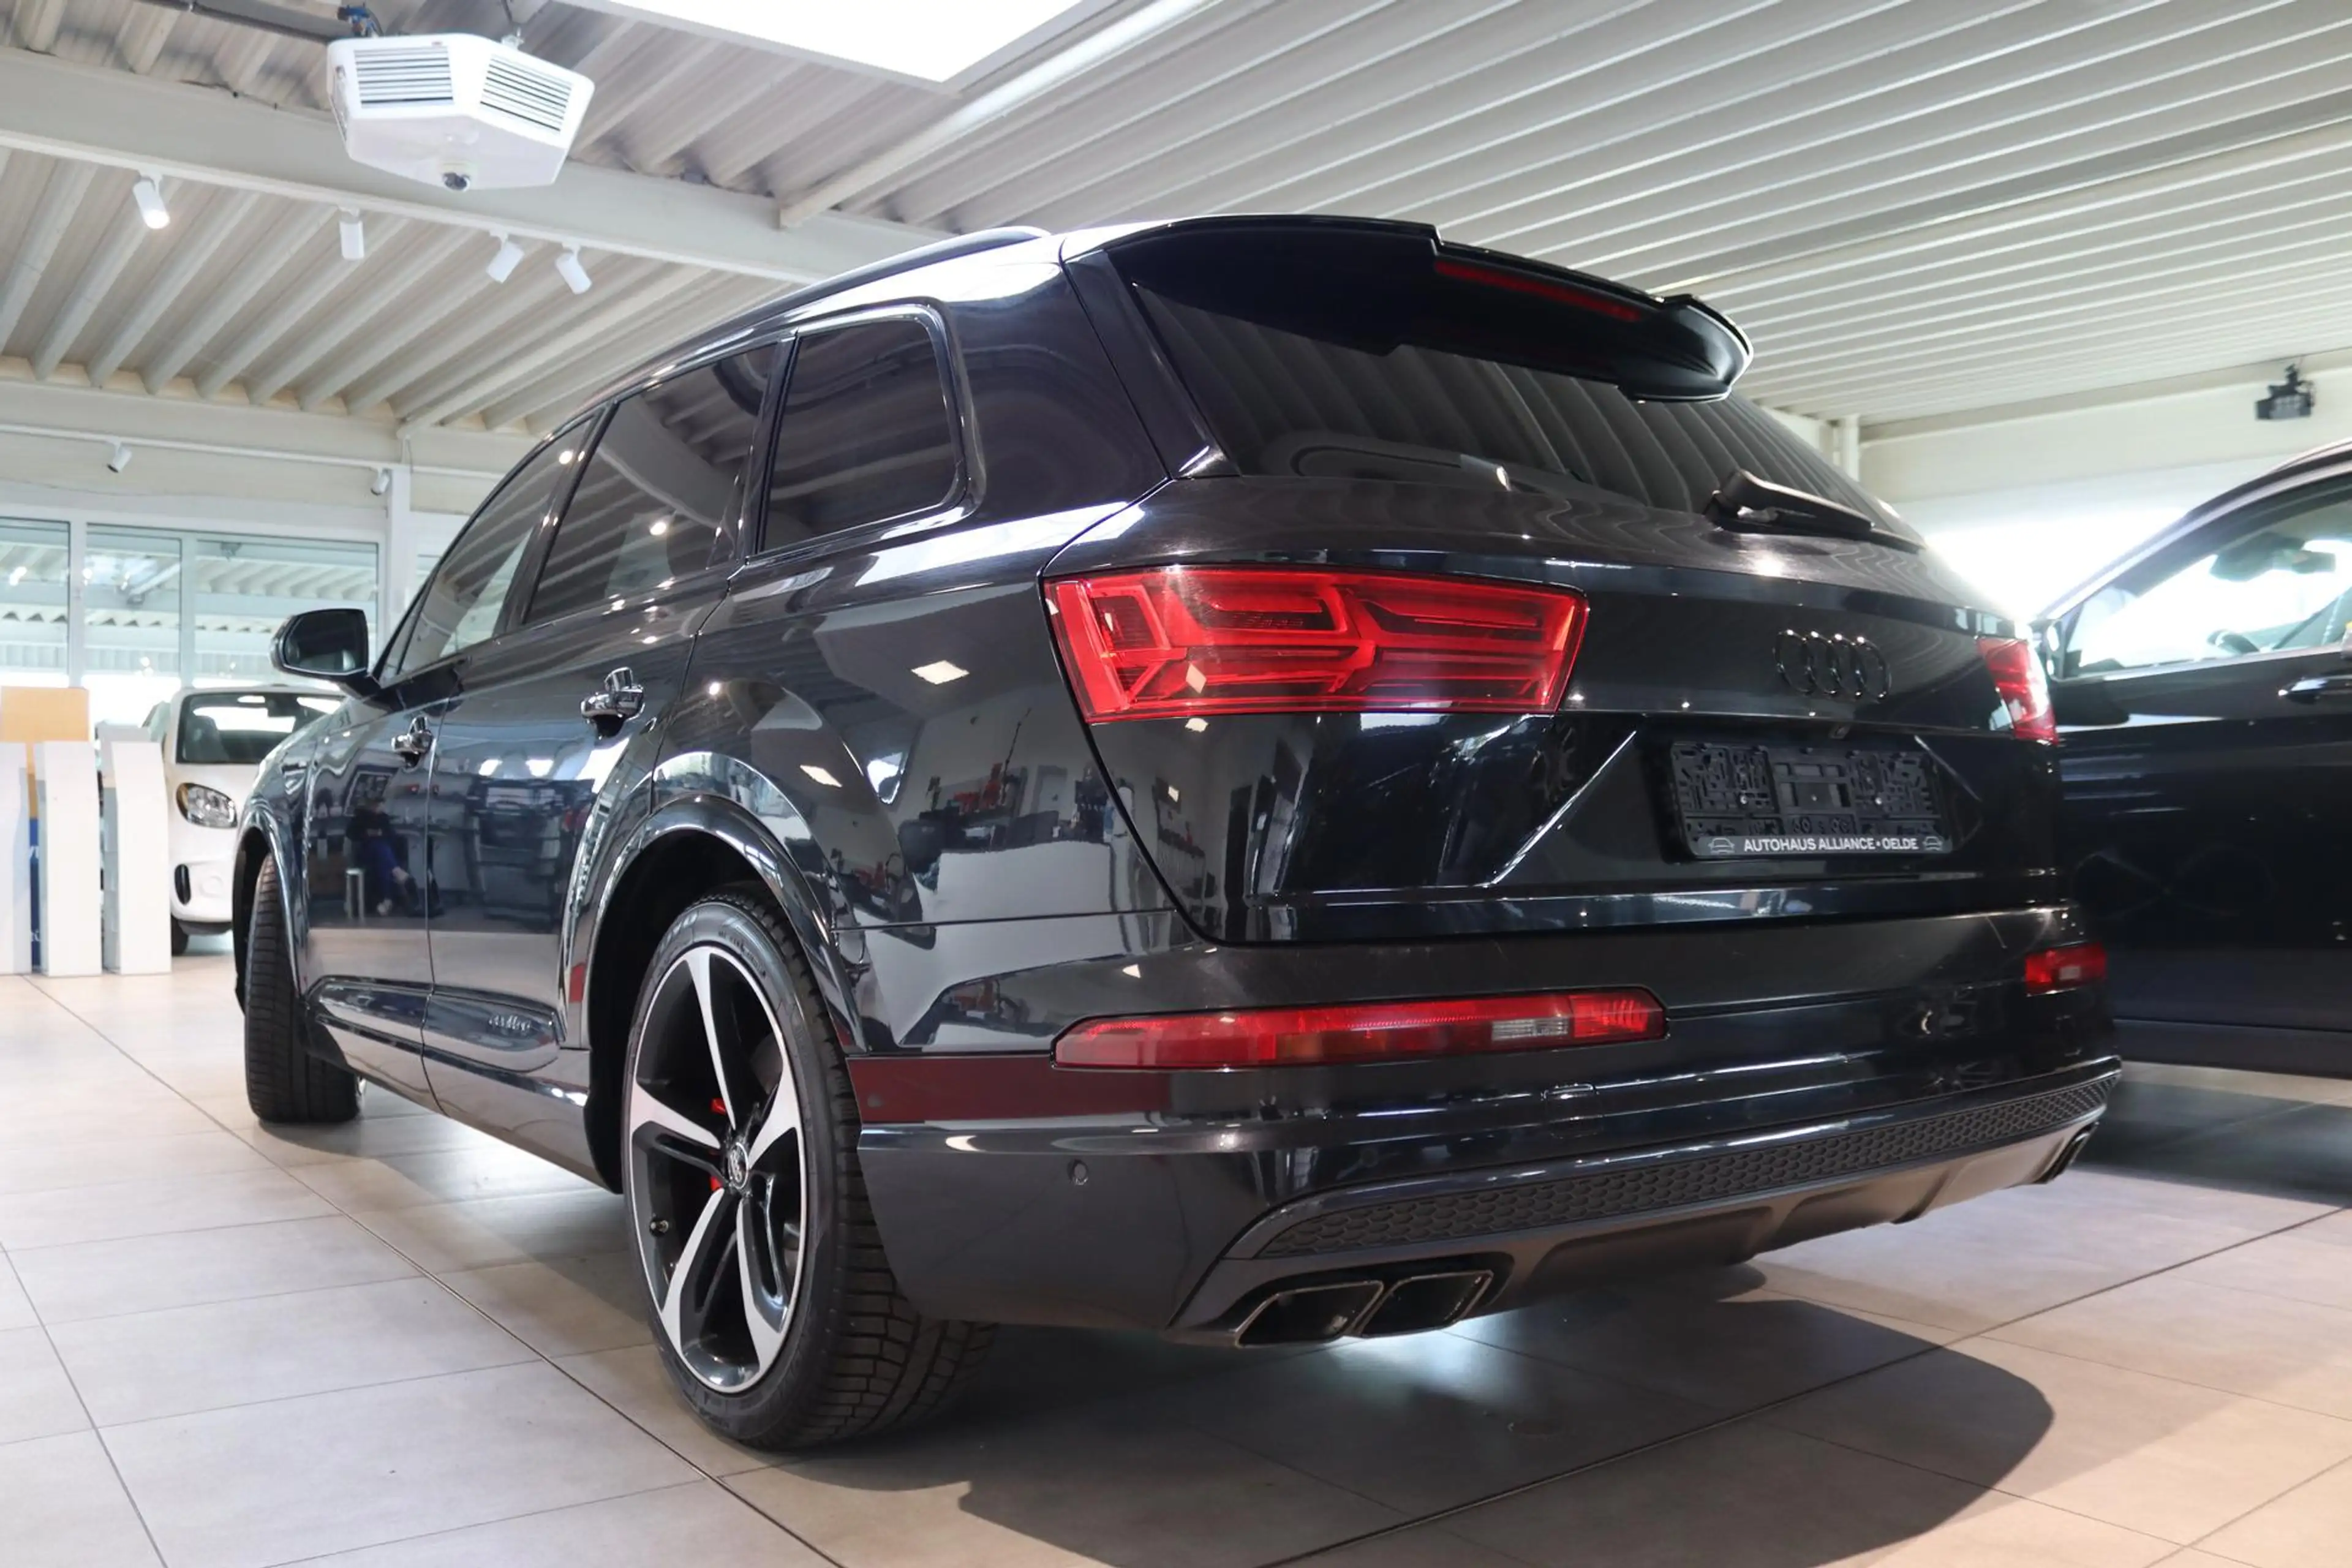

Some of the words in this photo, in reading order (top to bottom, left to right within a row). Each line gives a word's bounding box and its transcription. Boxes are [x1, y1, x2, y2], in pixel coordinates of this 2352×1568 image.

[1744, 837, 1816, 852] AUTOHAUS
[1819, 837, 1875, 850] ALLIANCE
[1882, 837, 1919, 850] OELDE
